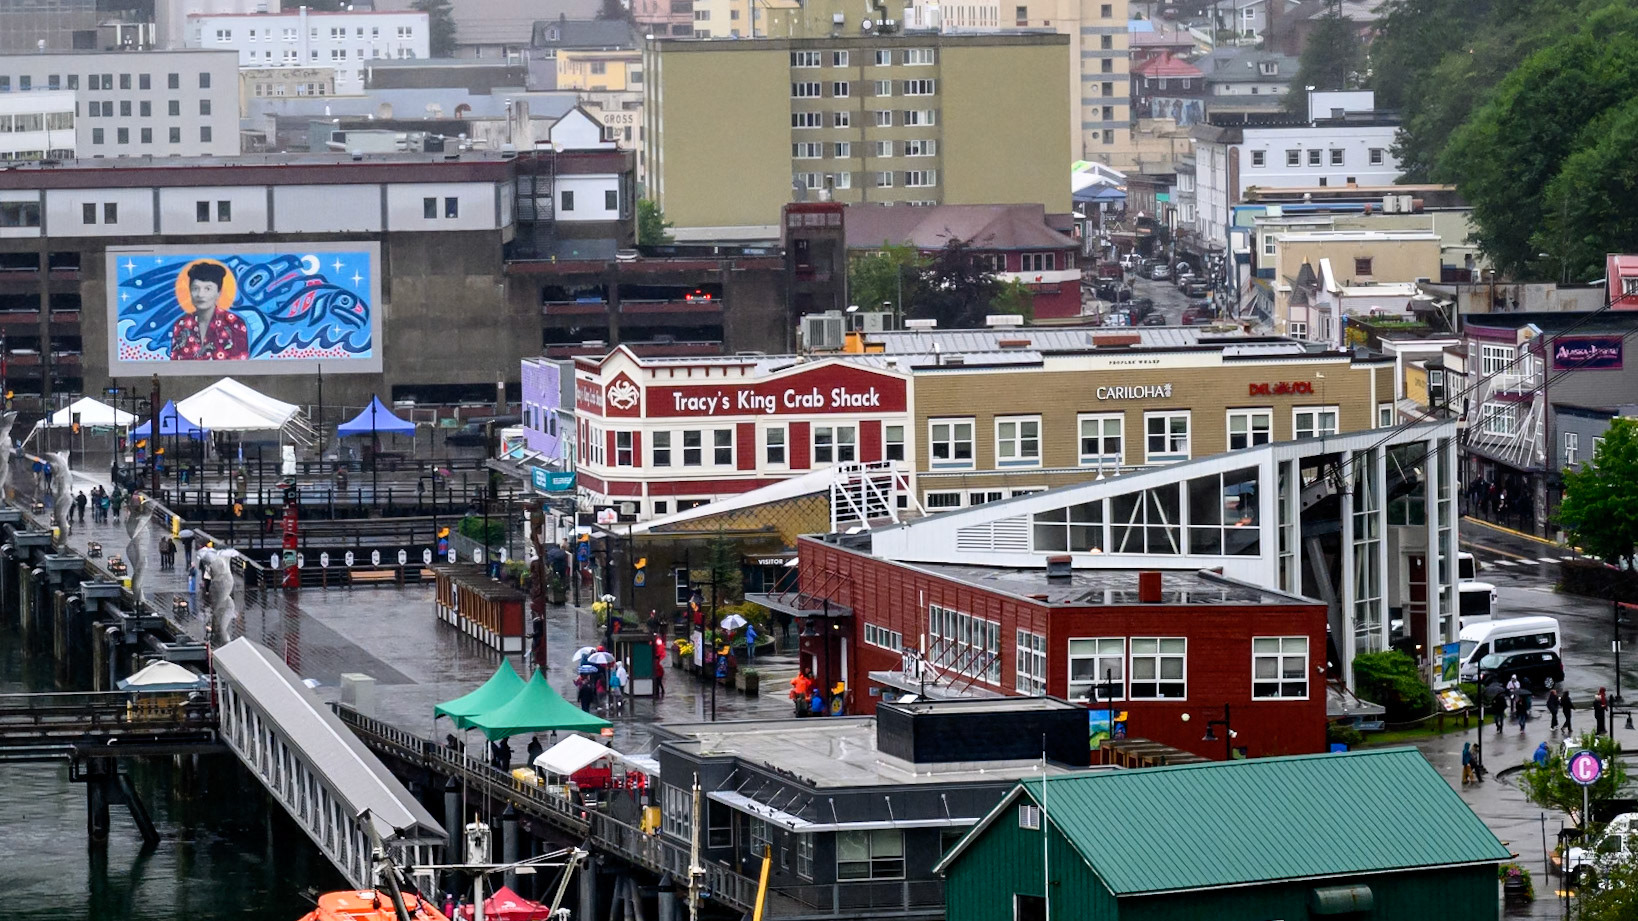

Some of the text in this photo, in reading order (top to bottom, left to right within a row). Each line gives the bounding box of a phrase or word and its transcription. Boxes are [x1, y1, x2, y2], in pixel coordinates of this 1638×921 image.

[604, 114, 633, 124] GROSS
[673, 386, 880, 415] Tracy's King Crab Shack
[1096, 385, 1165, 400] CARILOHA
[1579, 757, 1591, 779] C
